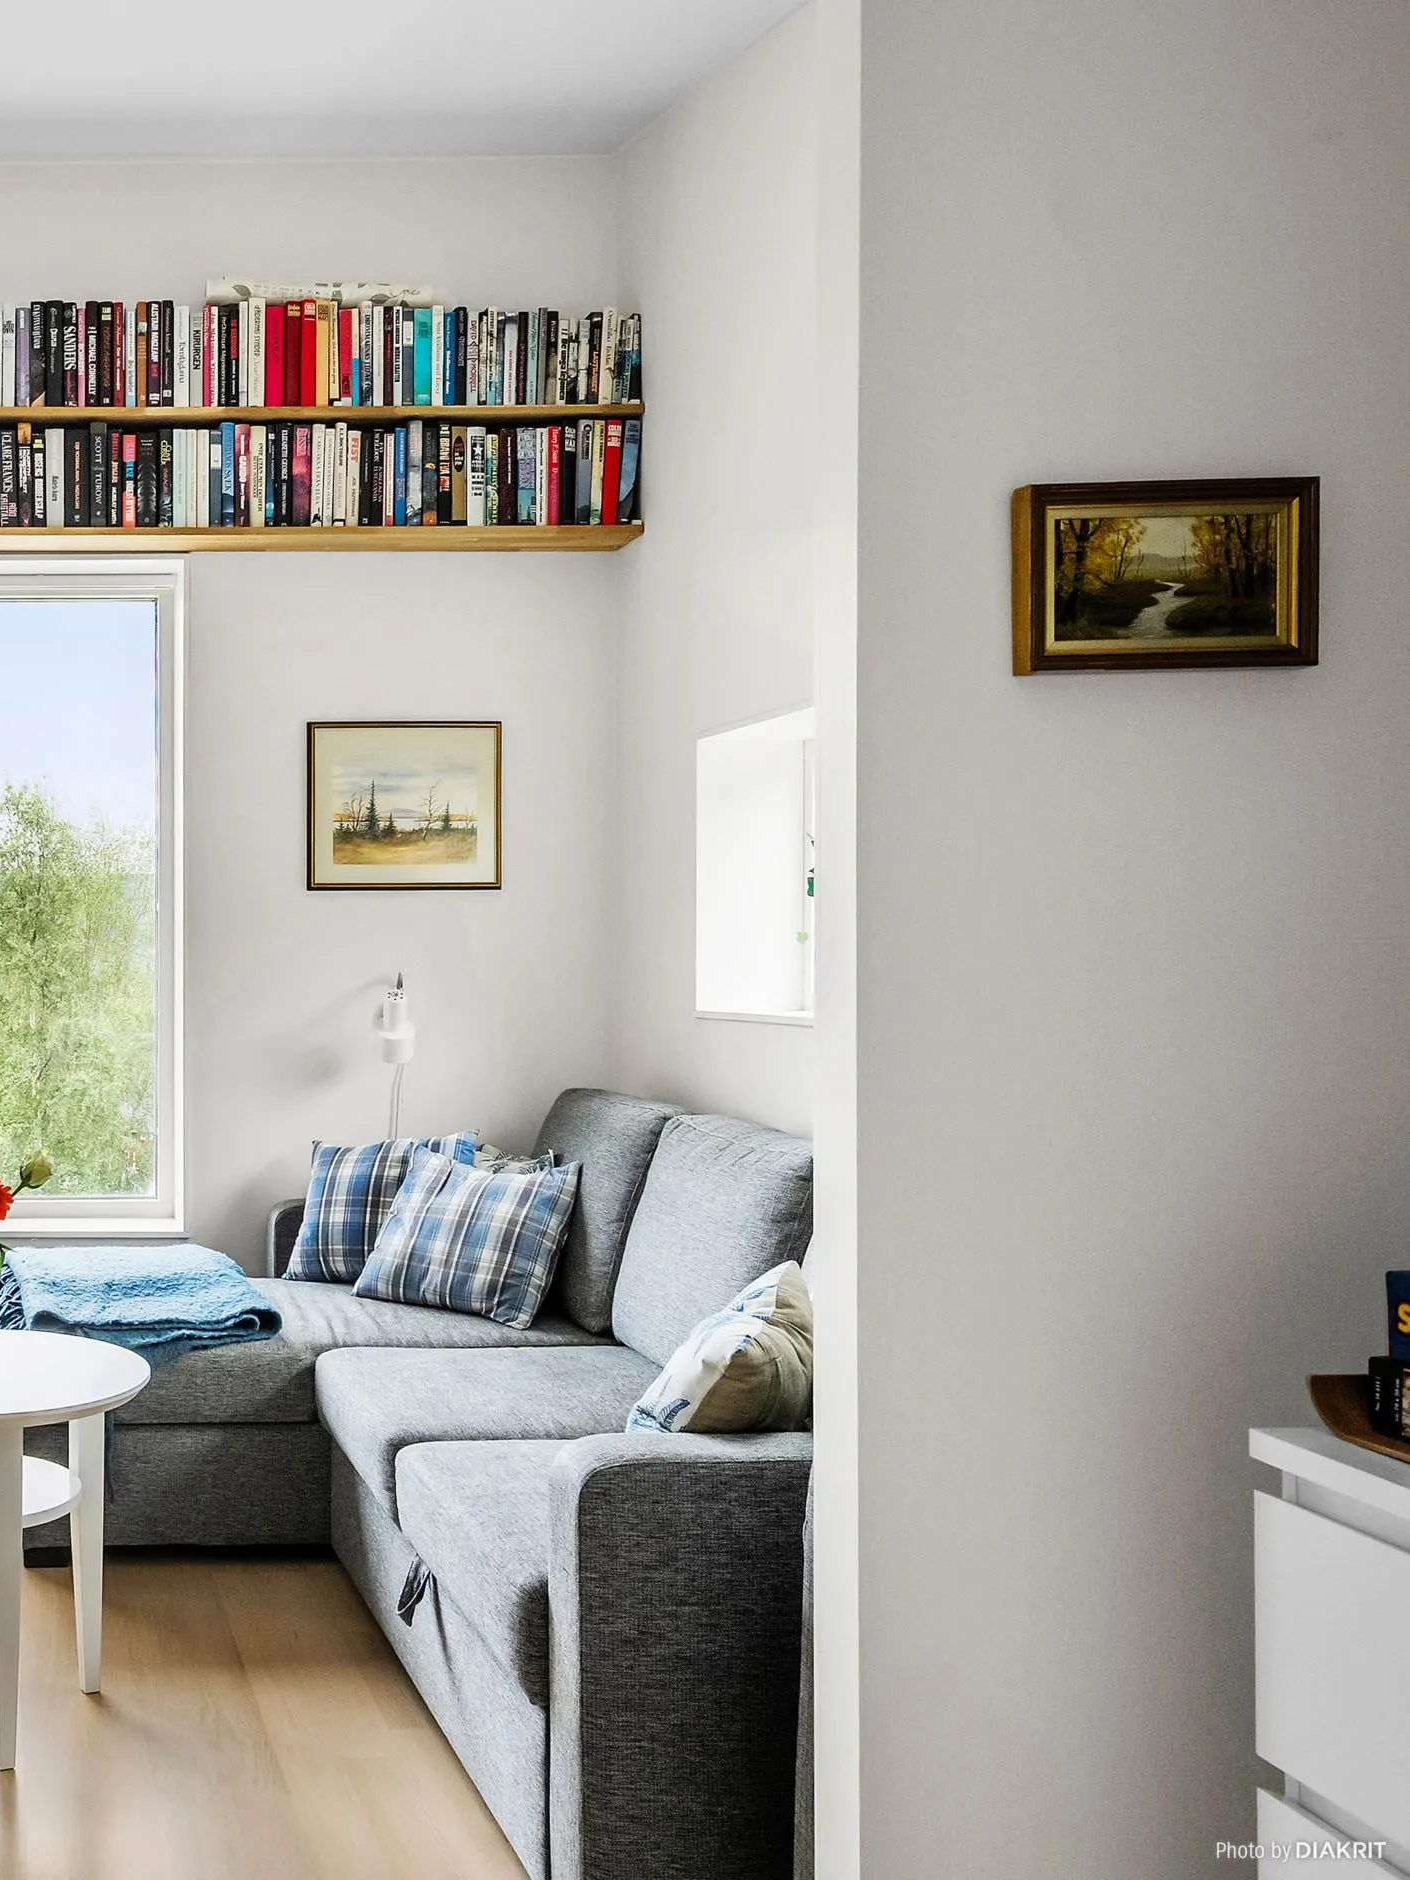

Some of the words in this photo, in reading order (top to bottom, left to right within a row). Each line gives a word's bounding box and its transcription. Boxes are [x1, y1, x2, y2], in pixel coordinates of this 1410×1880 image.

[64, 326, 76, 370] SANDERS
[88, 335, 96, 363] MICHAEL
[1, 435, 12, 460] CLARE
[94, 436, 102, 463] SCOTT
[439, 438, 449, 460] BRAVO
[2, 461, 13, 492] FRANCIS
